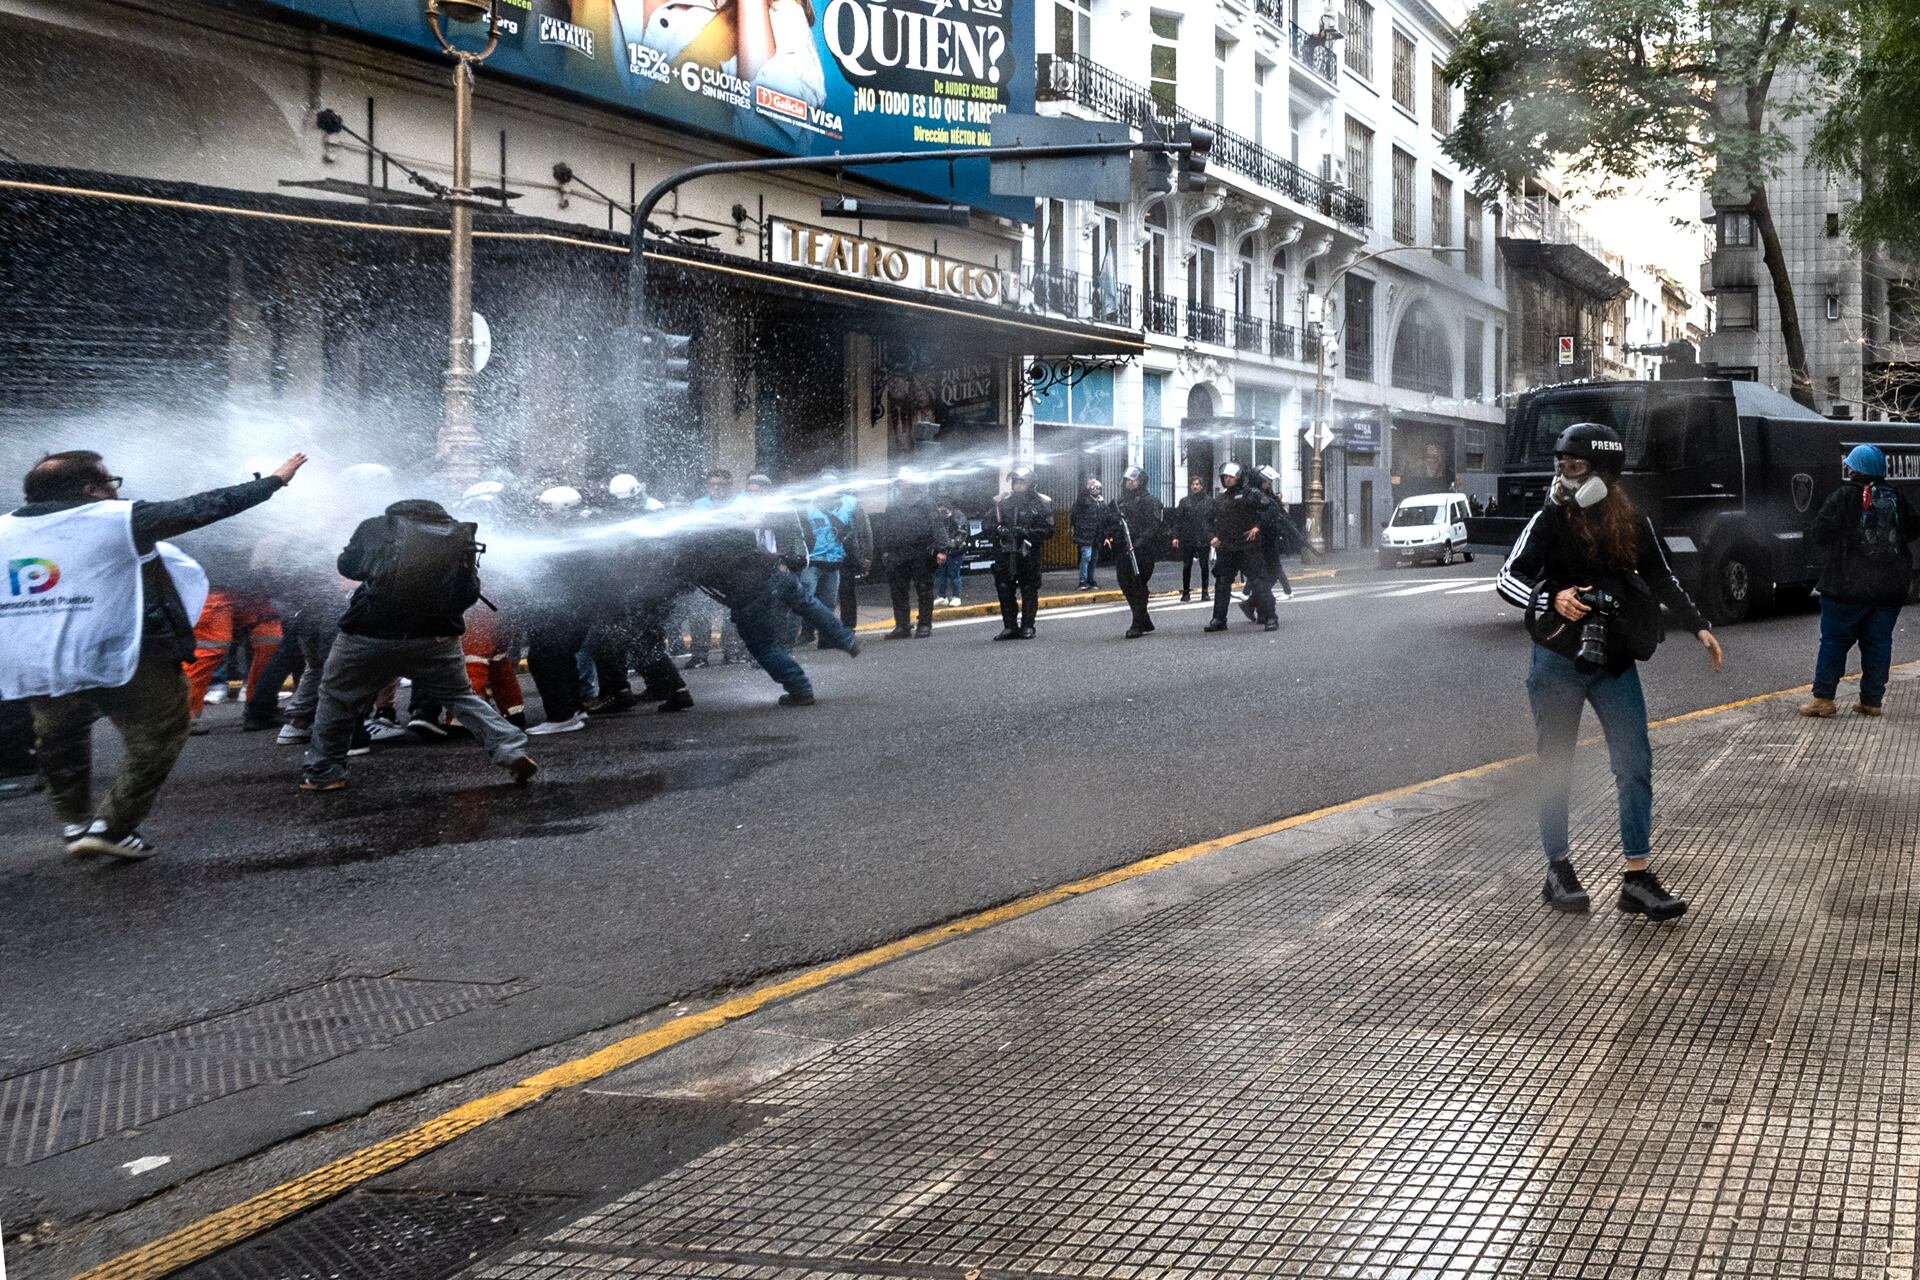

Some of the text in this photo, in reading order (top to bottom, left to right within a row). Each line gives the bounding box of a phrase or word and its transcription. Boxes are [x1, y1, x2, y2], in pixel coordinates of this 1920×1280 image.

[823, 0, 1006, 84] QUIÉN?
[628, 42, 670, 75] 15%
[701, 67, 751, 97] CUOTAS
[630, 64, 670, 84] DE AHORRO
[702, 85, 751, 109] SIN INTERÉS
[934, 79, 998, 100] De AUDREY SCHEBAT
[773, 95, 804, 116] Galicia
[854, 87, 875, 115] ¡NO
[879, 90, 910, 116] TODO
[912, 94, 926, 118] ES
[929, 96, 941, 119] LO
[944, 97, 965, 123] QUE
[808, 106, 843, 132] VISA
[914, 125, 949, 143] Dirección
[950, 127, 977, 145] HÉCTOR
[784, 223, 999, 300] TEATRO LICEO
[1591, 440, 1624, 452] PRENSA
[1892, 455, 1903, 477] LA
[1905, 455, 1920, 477] CIU
